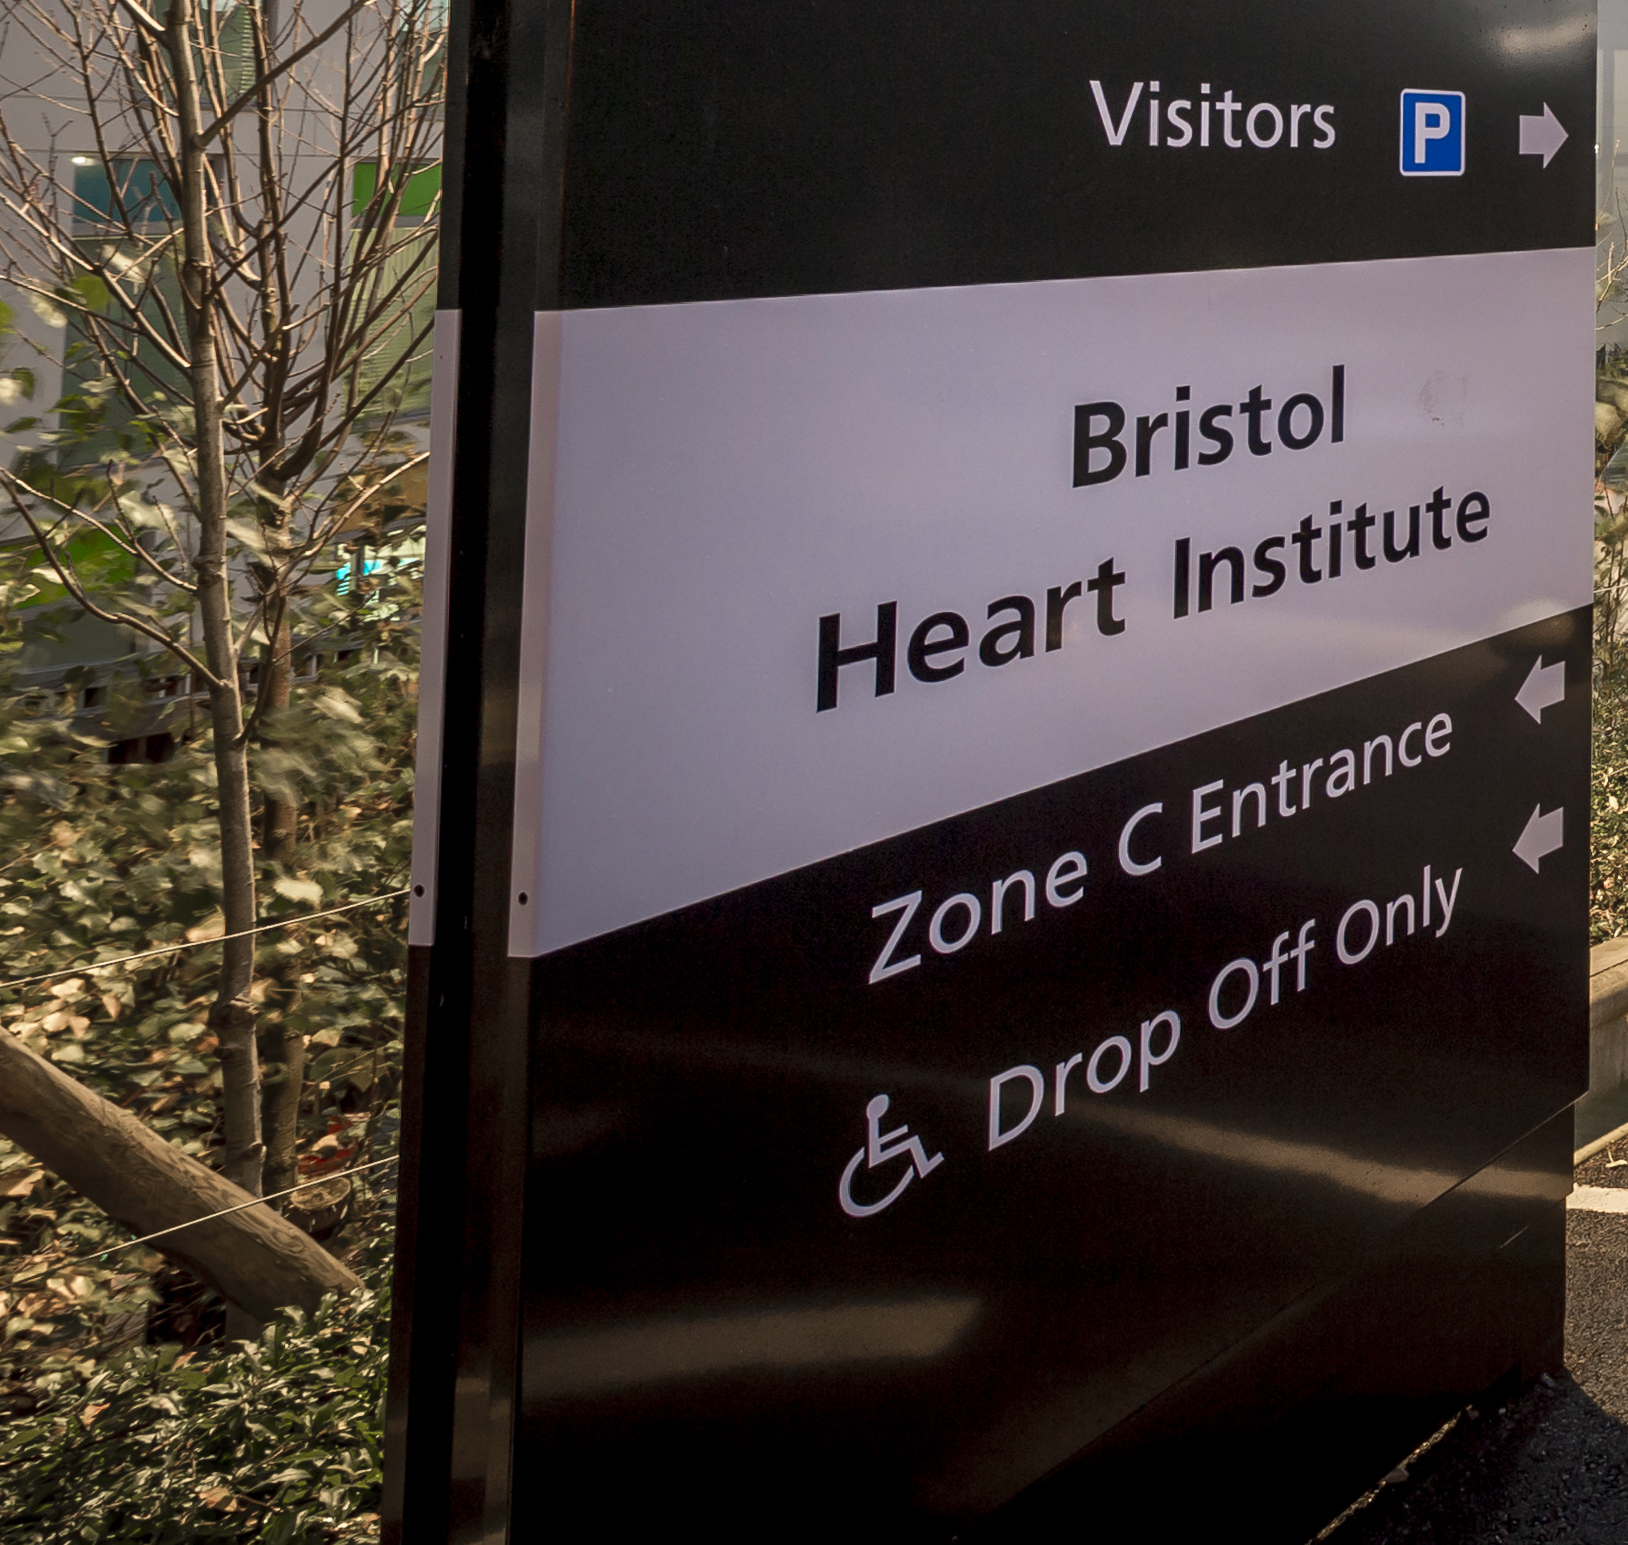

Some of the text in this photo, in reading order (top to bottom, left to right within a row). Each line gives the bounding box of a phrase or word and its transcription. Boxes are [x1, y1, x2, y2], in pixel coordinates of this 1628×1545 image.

[1089, 79, 1336, 149] Visitors
[1072, 364, 1346, 489] Bristol
[816, 486, 1491, 714] Heart Institute
[868, 712, 1453, 985] Zone C Entrance
[988, 864, 1463, 1152] Drop Off Only
